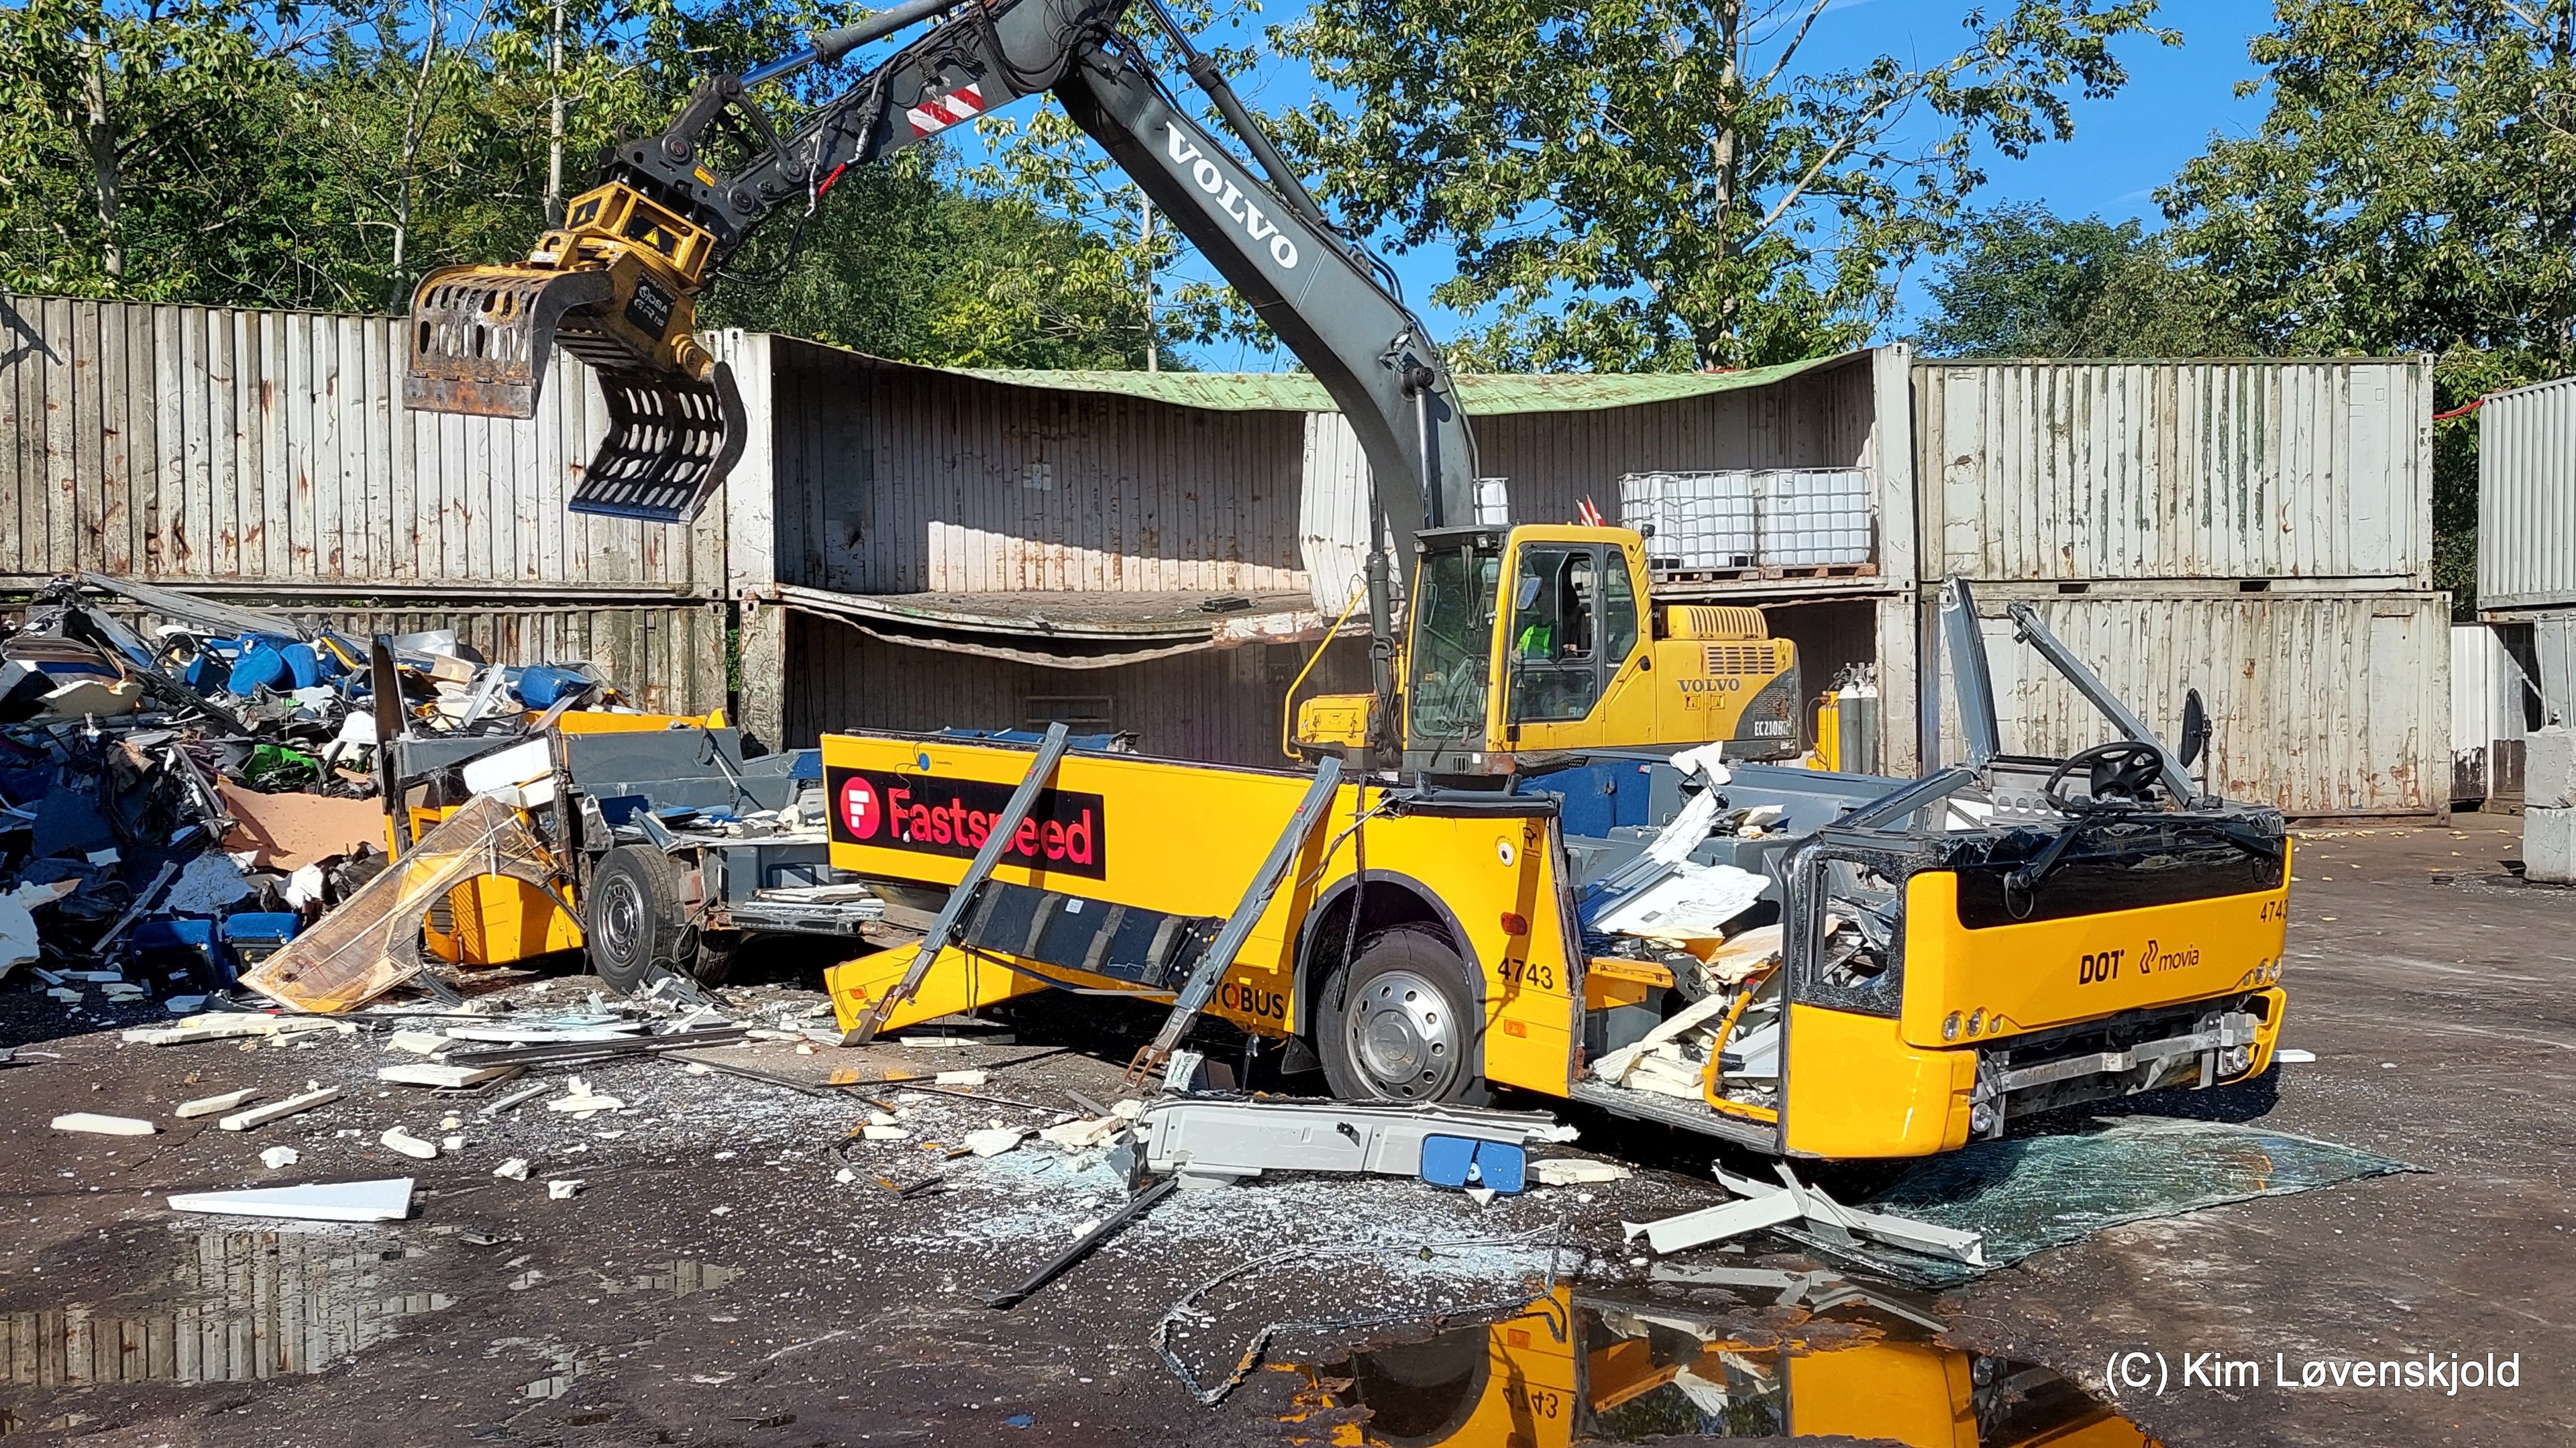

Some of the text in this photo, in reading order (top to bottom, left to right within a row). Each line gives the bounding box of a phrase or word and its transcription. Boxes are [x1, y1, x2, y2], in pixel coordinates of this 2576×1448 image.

[1165, 121, 1299, 269] VOLVO
[1677, 678, 1740, 692] VOLVO
[2260, 898, 2288, 923] 4743
[1497, 956, 1554, 990] 4743
[2079, 949, 2125, 985] DOT
[2158, 944, 2200, 972] movia
